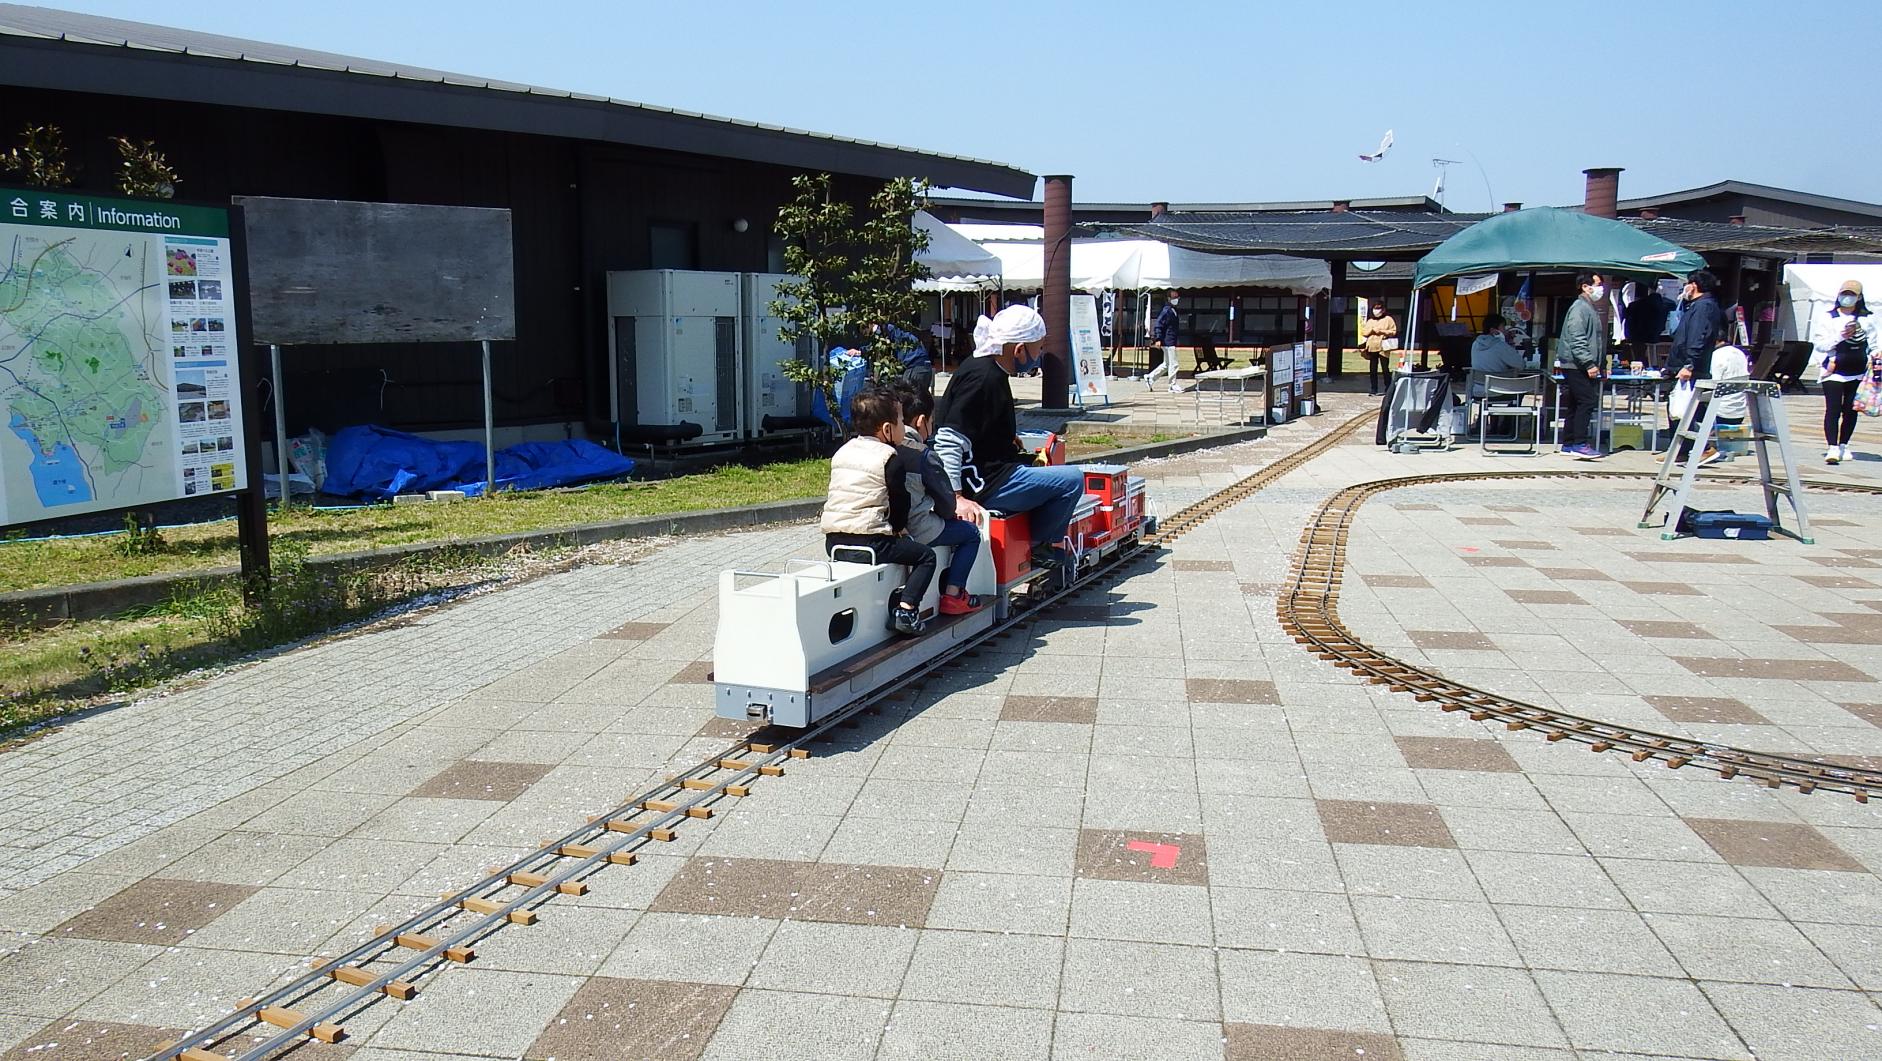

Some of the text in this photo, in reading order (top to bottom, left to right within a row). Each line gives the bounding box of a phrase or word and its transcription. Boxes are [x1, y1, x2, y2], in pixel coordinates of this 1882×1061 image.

[10, 197, 85, 222] 合案内
[98, 207, 181, 229] Information
